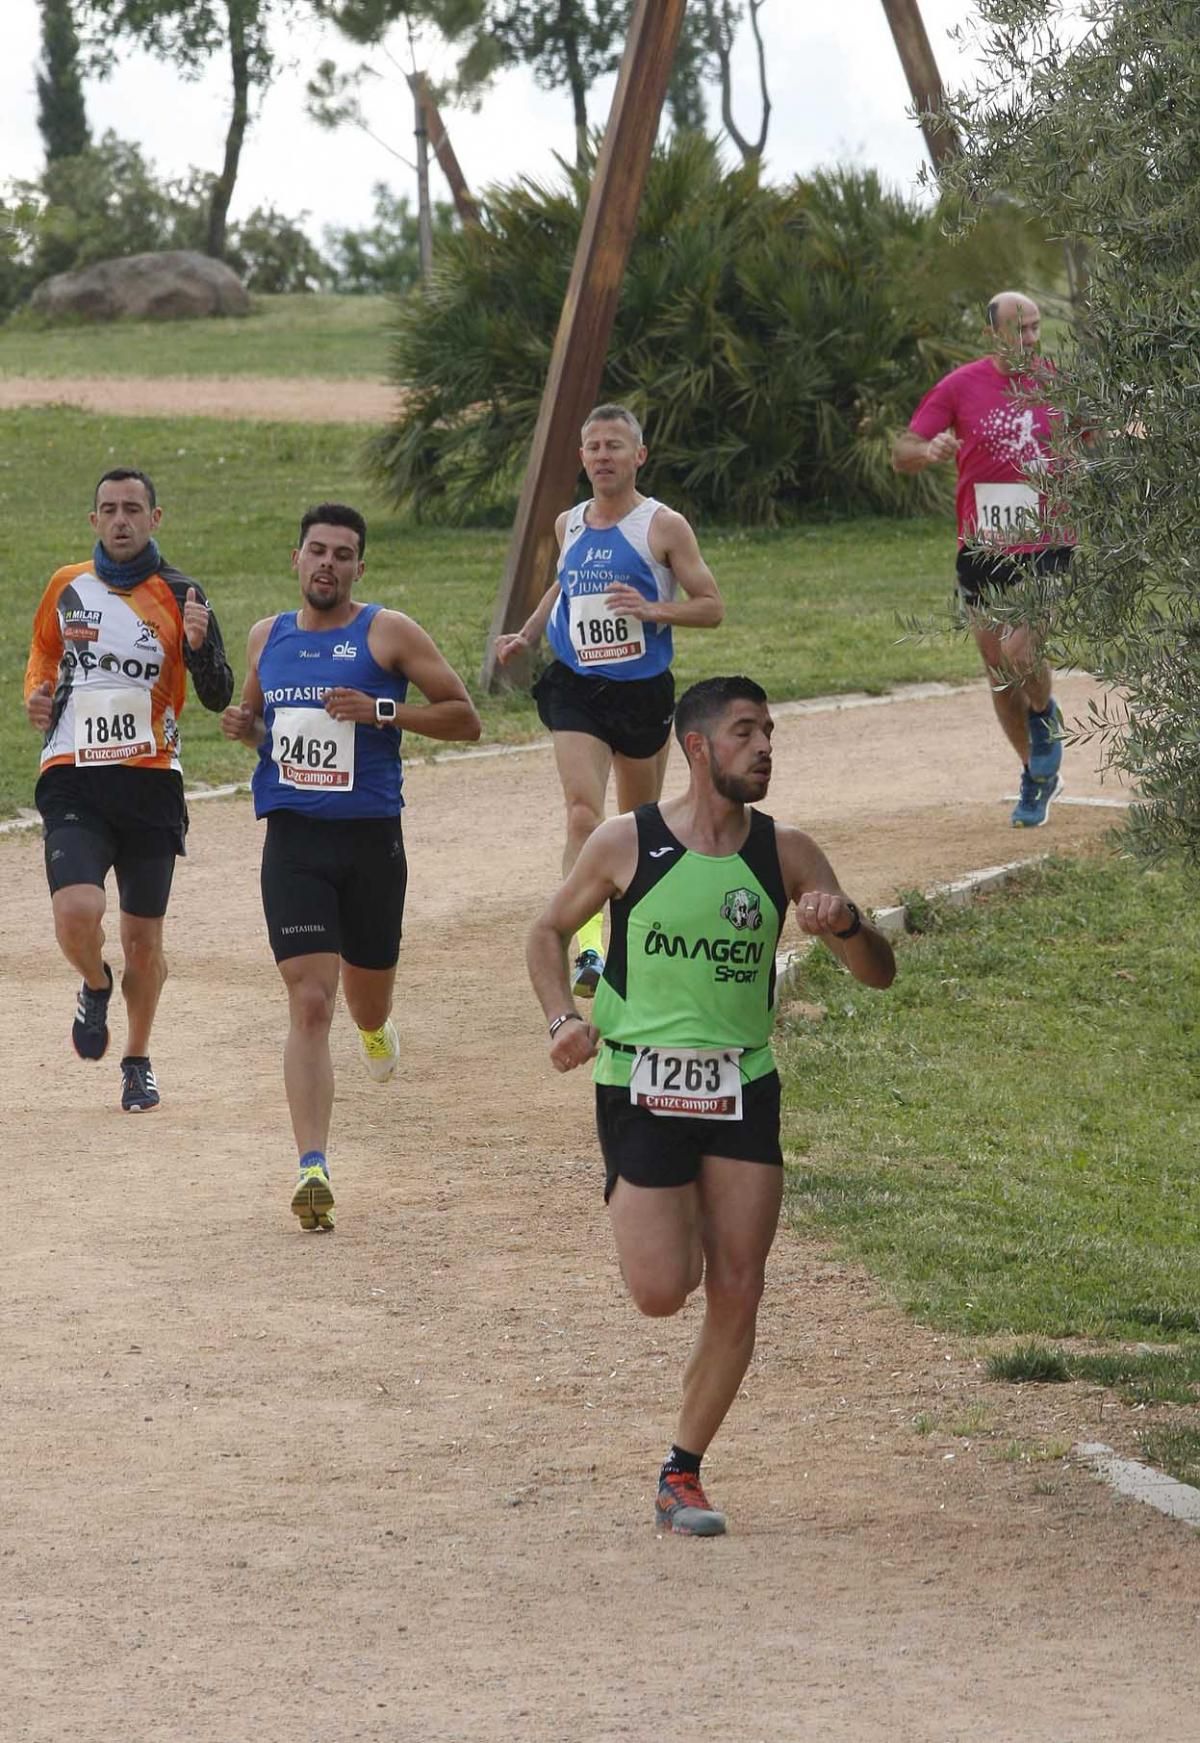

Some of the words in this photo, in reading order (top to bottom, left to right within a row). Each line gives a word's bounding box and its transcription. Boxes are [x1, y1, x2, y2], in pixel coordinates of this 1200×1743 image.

[982, 505, 1026, 527] 1818
[580, 570, 613, 580] VINOS
[72, 610, 100, 620] MILAR
[577, 618, 628, 645] 1866
[580, 647, 628, 660] Cruzcampo
[85, 714, 136, 744] 1848
[85, 746, 138, 760] Cruzcampo
[280, 735, 337, 768] 2462
[647, 1053, 721, 1092] 1263
[645, 1096, 718, 1112] Cruzcampo
